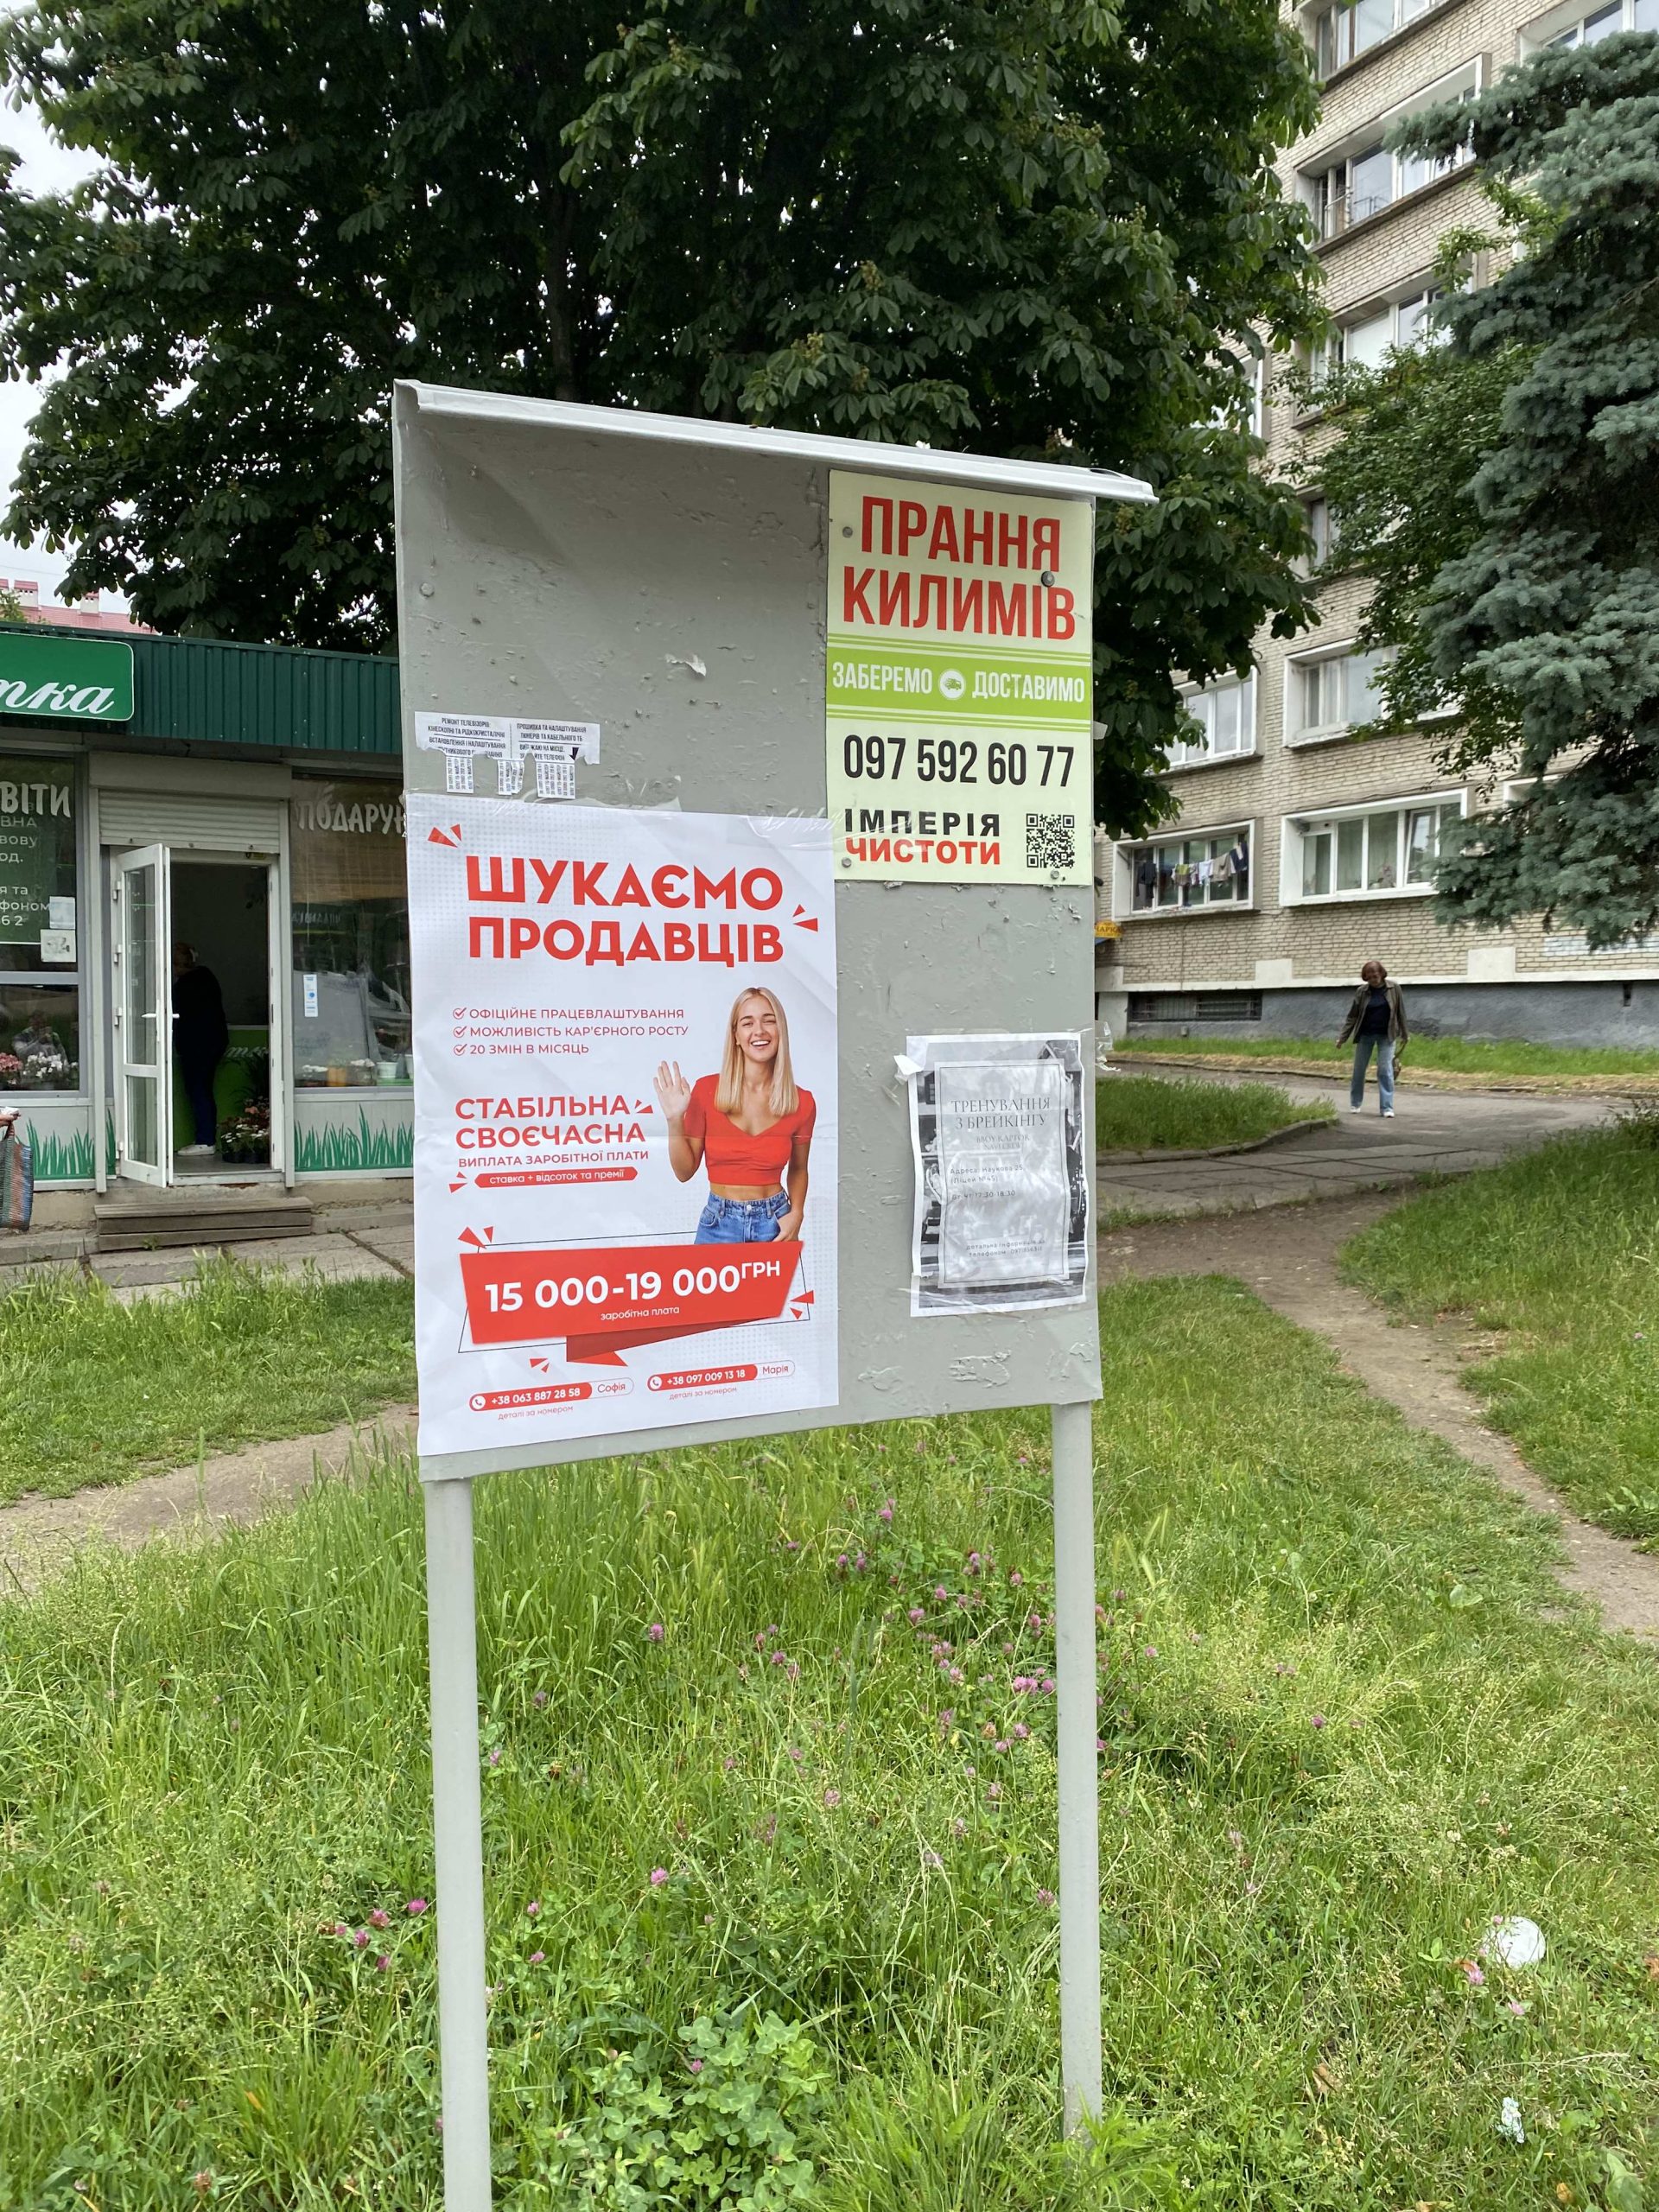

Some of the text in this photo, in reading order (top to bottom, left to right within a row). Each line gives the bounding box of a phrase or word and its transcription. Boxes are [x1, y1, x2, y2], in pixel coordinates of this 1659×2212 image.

[861, 495, 1061, 572] ПРАННЯ
[842, 566, 1076, 641] КИЛИМІВ
[832, 662, 1085, 703] ЗАБЕРЕМО ДОСТАВИМО
[843, 734, 1075, 788] 097 592 60 77
[845, 808, 1000, 837] ІМПЕРІЯ
[846, 837, 1001, 865] ЧИСТОТИ
[12, 887, 29, 895] та
[466, 855, 783, 910] ШУКАЄМО
[468, 916, 784, 968] ПРОДАВЦІВ
[469, 1007, 684, 1020] ОФІЦІЙНЕ ПРАЦЕВЛАШТУВАННЯ
[470, 1027, 689, 1037] МОЖЛИВІСТЬ КАР'ЄРНОГО РОСТУ
[470, 1044, 589, 1055] 20 ЗМІН В МІСЯЦЬ
[454, 1095, 631, 1120] СТАБІЛЬНА
[950, 1096, 1051, 1113] ТРЕНУВАННЯ
[954, 1113, 1046, 1130] З БРЕЙКІНГУ
[455, 1123, 646, 1149] СВОЄЧАСНА
[459, 1150, 649, 1167] ВИПЛАТА ЗАРОБІТНОЇ ПЛАТИ
[489, 1175, 525, 1185] ставка
[536, 1173, 578, 1183] відсоток
[594, 1169, 625, 1181] премії
[485, 1282, 523, 1313] 15
[535, 1271, 662, 1308] 000-19
[741, 1260, 780, 1279] ГРН
[601, 1306, 680, 1321] заробітна плата
[667, 1370, 746, 1385] +38 097 009 13 18
[762, 1364, 789, 1376] Марія
[492, 1387, 581, 1405] +38 063 887 28 58
[597, 1382, 626, 1394] Софія
[669, 1389, 692, 1401] деталі
[705, 1387, 737, 1396] номером
[498, 1406, 574, 1421] деталі за номером
